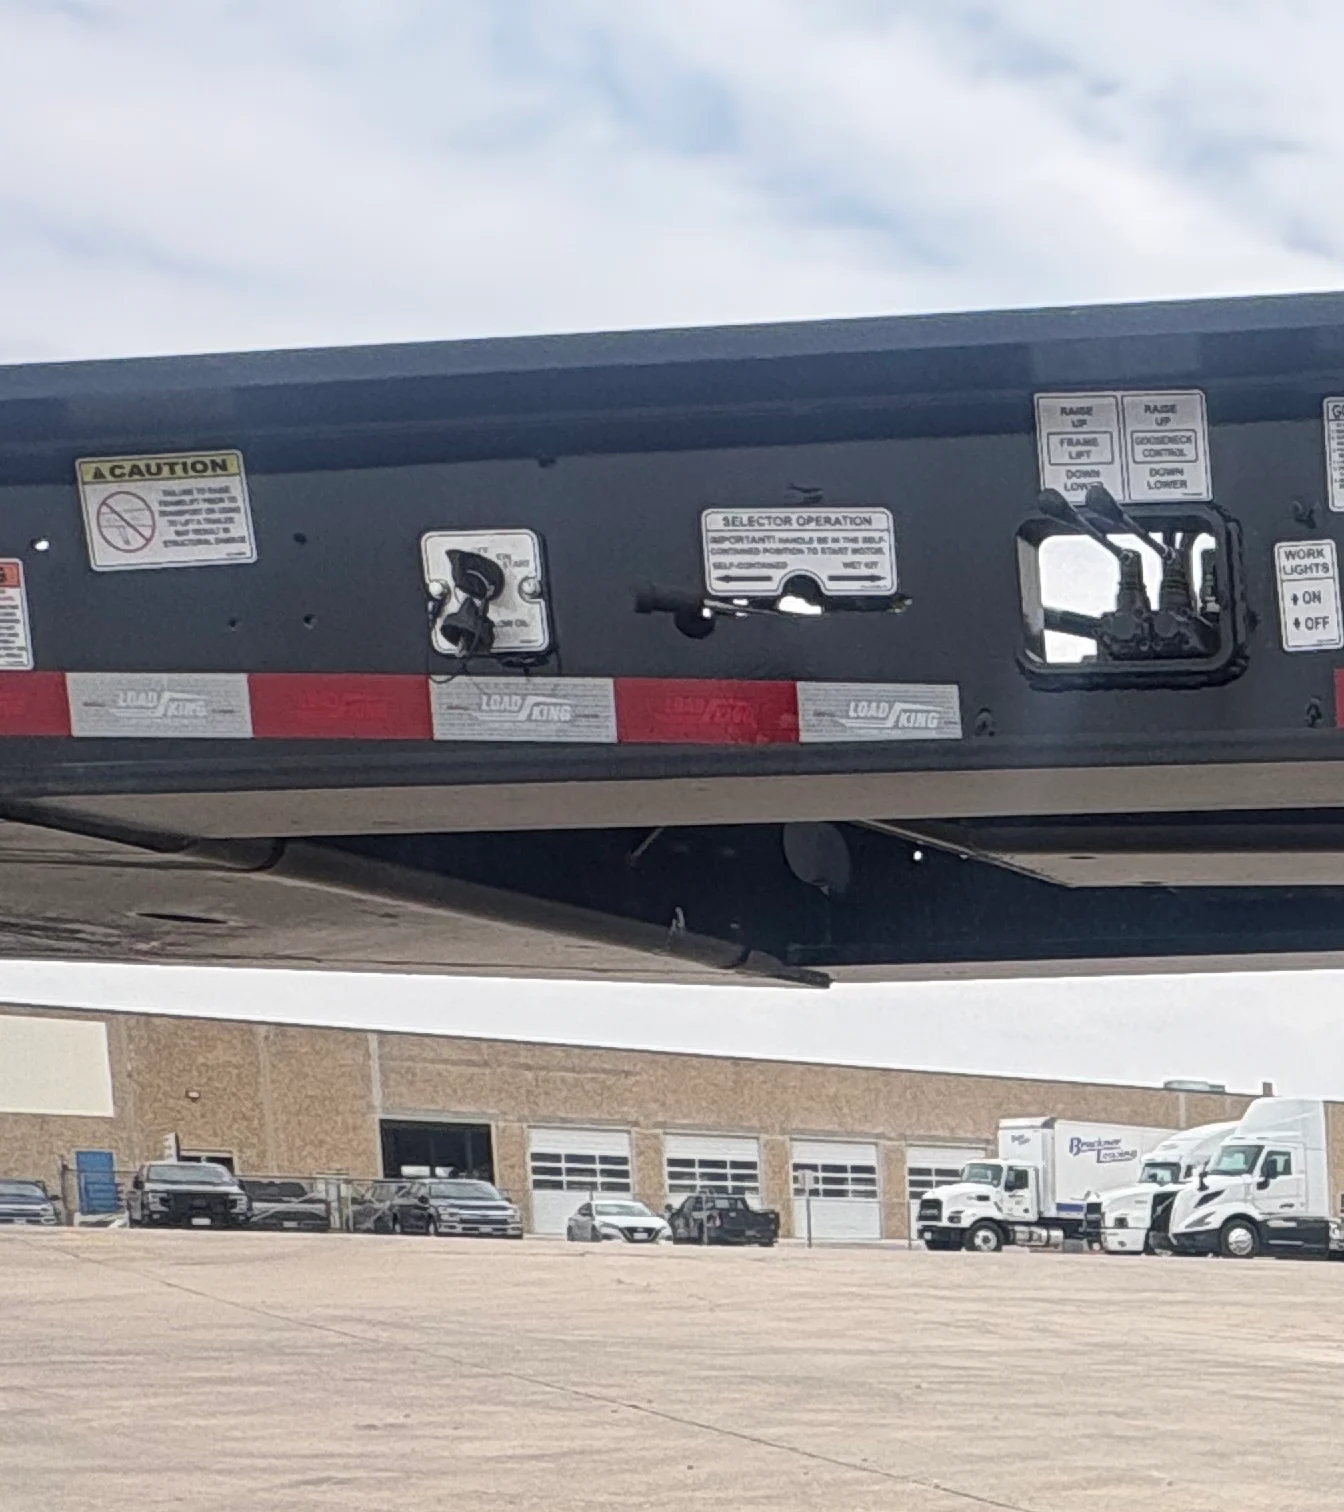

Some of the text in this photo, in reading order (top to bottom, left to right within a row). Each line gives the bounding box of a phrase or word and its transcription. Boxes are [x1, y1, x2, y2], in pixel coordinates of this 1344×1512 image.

[1061, 407, 1093, 416] RAISE
[1145, 405, 1177, 414] RAISE
[1071, 419, 1087, 428] UP
[1155, 417, 1171, 426] UP
[1060, 437, 1098, 447] FRAME
[1135, 435, 1192, 445] GOOSENECK
[1069, 451, 1092, 460] LIFT
[1143, 449, 1187, 457] CONTROL
[109, 459, 228, 479] CAUTION
[1150, 468, 1184, 477] DOWN
[1066, 470, 1101, 479] DOWN
[1147, 480, 1187, 490] LOWER
[723, 515, 872, 527] SELECTOR OPERATION
[1284, 550, 1325, 560] WORK
[1283, 563, 1329, 575] LIGHTS
[1303, 591, 1321, 604] ON
[1305, 617, 1329, 630] OFF
[481, 695, 572, 721] LOAD KING
[849, 701, 940, 728] LOAD KING
